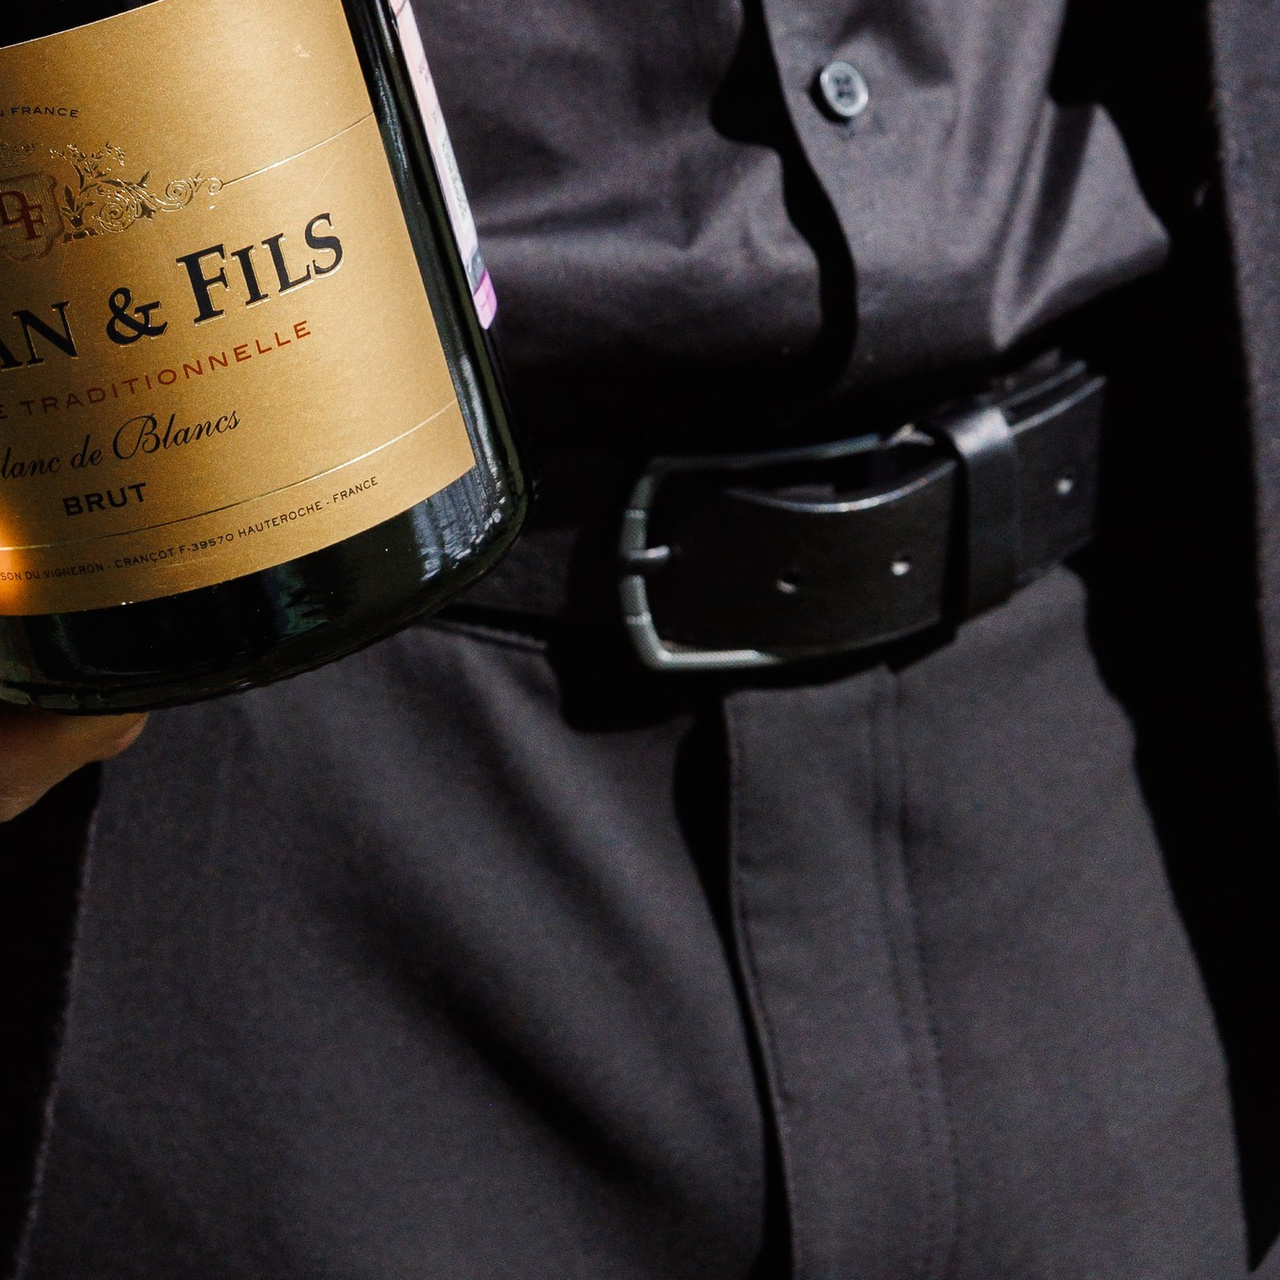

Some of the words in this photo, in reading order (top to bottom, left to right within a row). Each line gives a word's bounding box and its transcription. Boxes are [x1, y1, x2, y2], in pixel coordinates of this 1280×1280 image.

[11, 106, 79, 118] FRANCE
[106, 287, 168, 346] &
[177, 212, 344, 326] FILS
[20, 320, 311, 412] TRADITIONNELLE
[70, 435, 102, 469] de
[112, 410, 240, 461] Blancs
[25, 571, 40, 580] DU
[45, 563, 104, 578] VIGNERON
[115, 548, 174, 568] CRANÇOT
[180, 533, 234, 554] F-39570
[237, 500, 323, 538] HAUTEROCHE
[332, 476, 378, 503] FRANCE
[63, 482, 147, 517] BRUT
